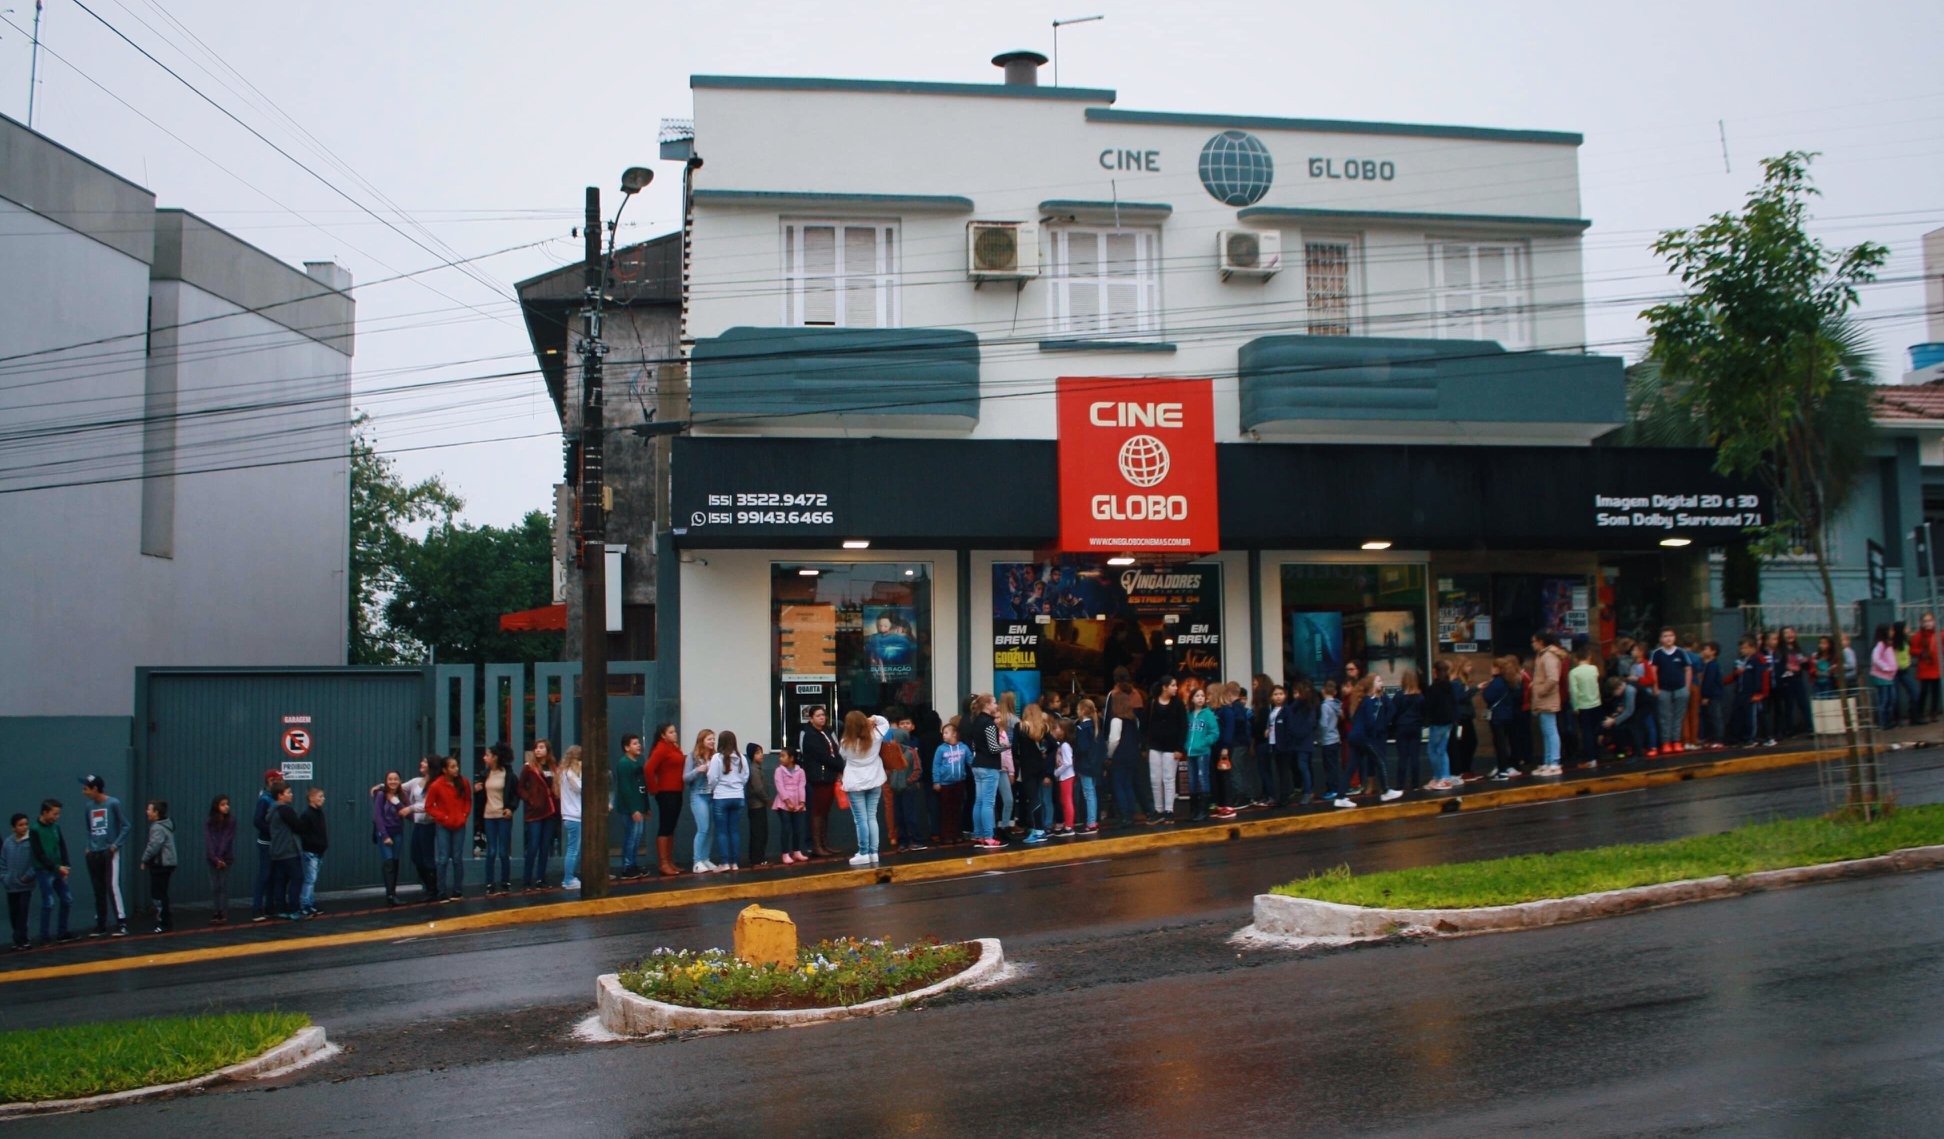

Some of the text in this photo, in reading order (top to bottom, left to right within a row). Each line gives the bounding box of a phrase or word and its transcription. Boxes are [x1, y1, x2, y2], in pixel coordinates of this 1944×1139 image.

[1100, 149, 1395, 181] CINE GLOBO
[1090, 401, 1183, 428] CINE
[736, 493, 828, 507] 3522.9472
[1595, 494, 1758, 511] Imagem Digital 2D e 3D
[1091, 494, 1188, 521] GLOBO
[737, 512, 834, 525] 99143.6466
[1597, 513, 1761, 529] Som Dolby Surround 7.1
[1009, 625, 1027, 634] EM
[1191, 624, 1209, 633] EM
[995, 635, 1037, 645] BREVE
[1178, 635, 1219, 644] BREVE
